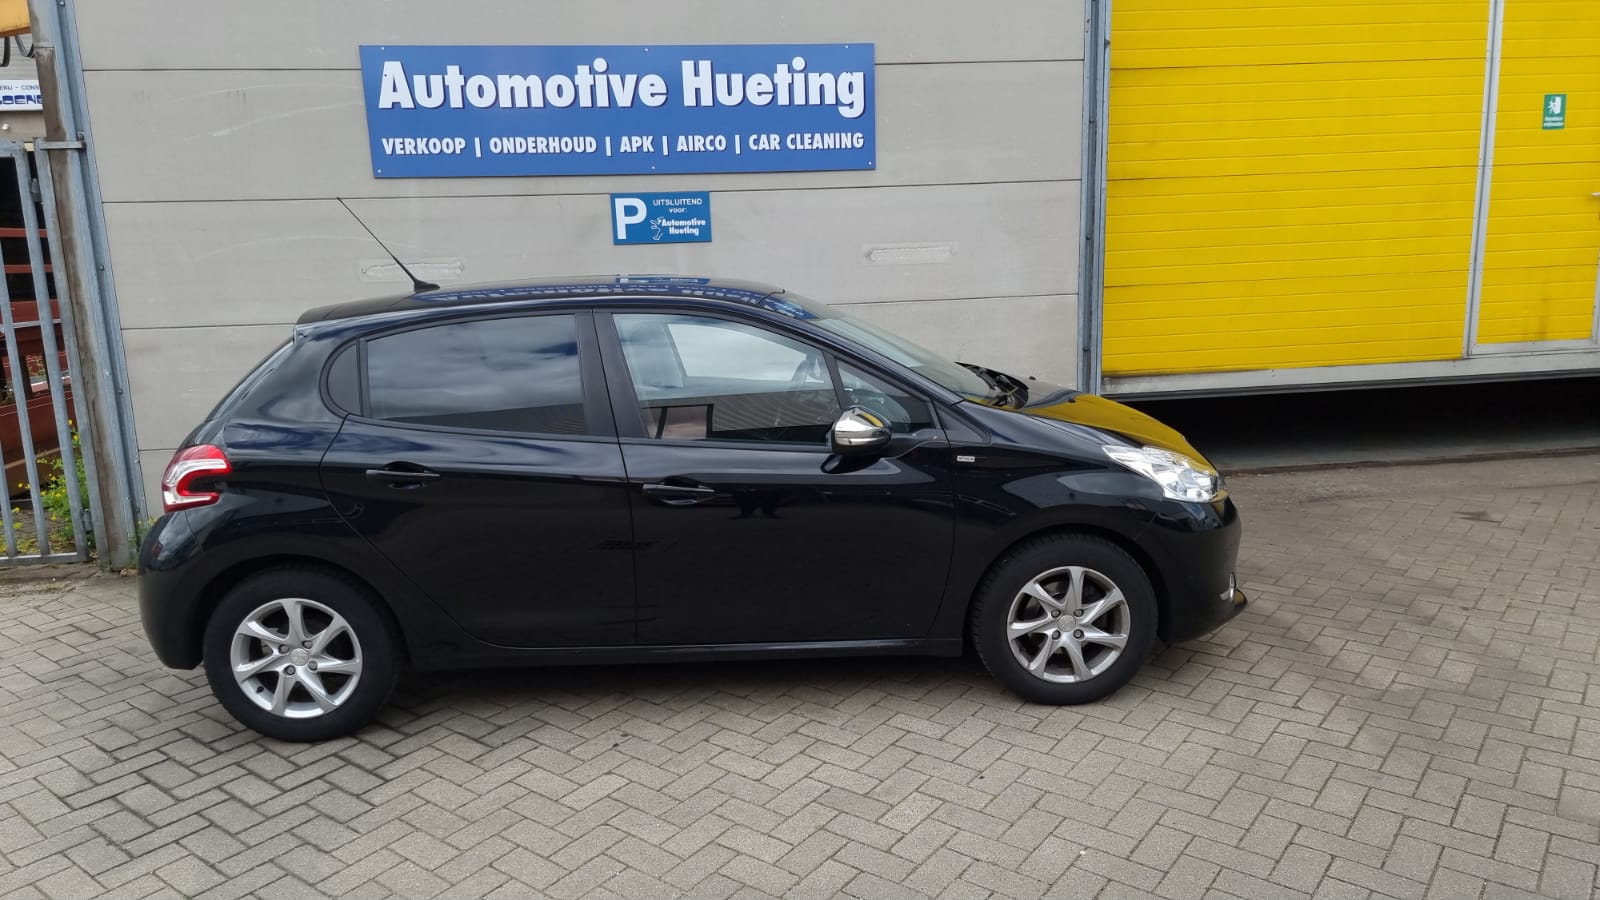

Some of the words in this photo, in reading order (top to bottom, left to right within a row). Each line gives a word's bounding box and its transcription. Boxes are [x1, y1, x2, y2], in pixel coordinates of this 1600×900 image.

[378, 57, 667, 109] Automotive
[681, 56, 866, 119] Hueting
[381, 137, 466, 155] VERKOOP
[489, 136, 597, 154] ONDERHOUD
[619, 135, 654, 153] APK
[676, 134, 727, 152] AIRCO
[748, 133, 781, 151] CAR
[786, 132, 865, 150] CLEANING
[652, 198, 703, 206] UITSLUITEND
[614, 197, 647, 240] P
[661, 217, 706, 227] Automotive
[669, 226, 700, 236] Hueting
